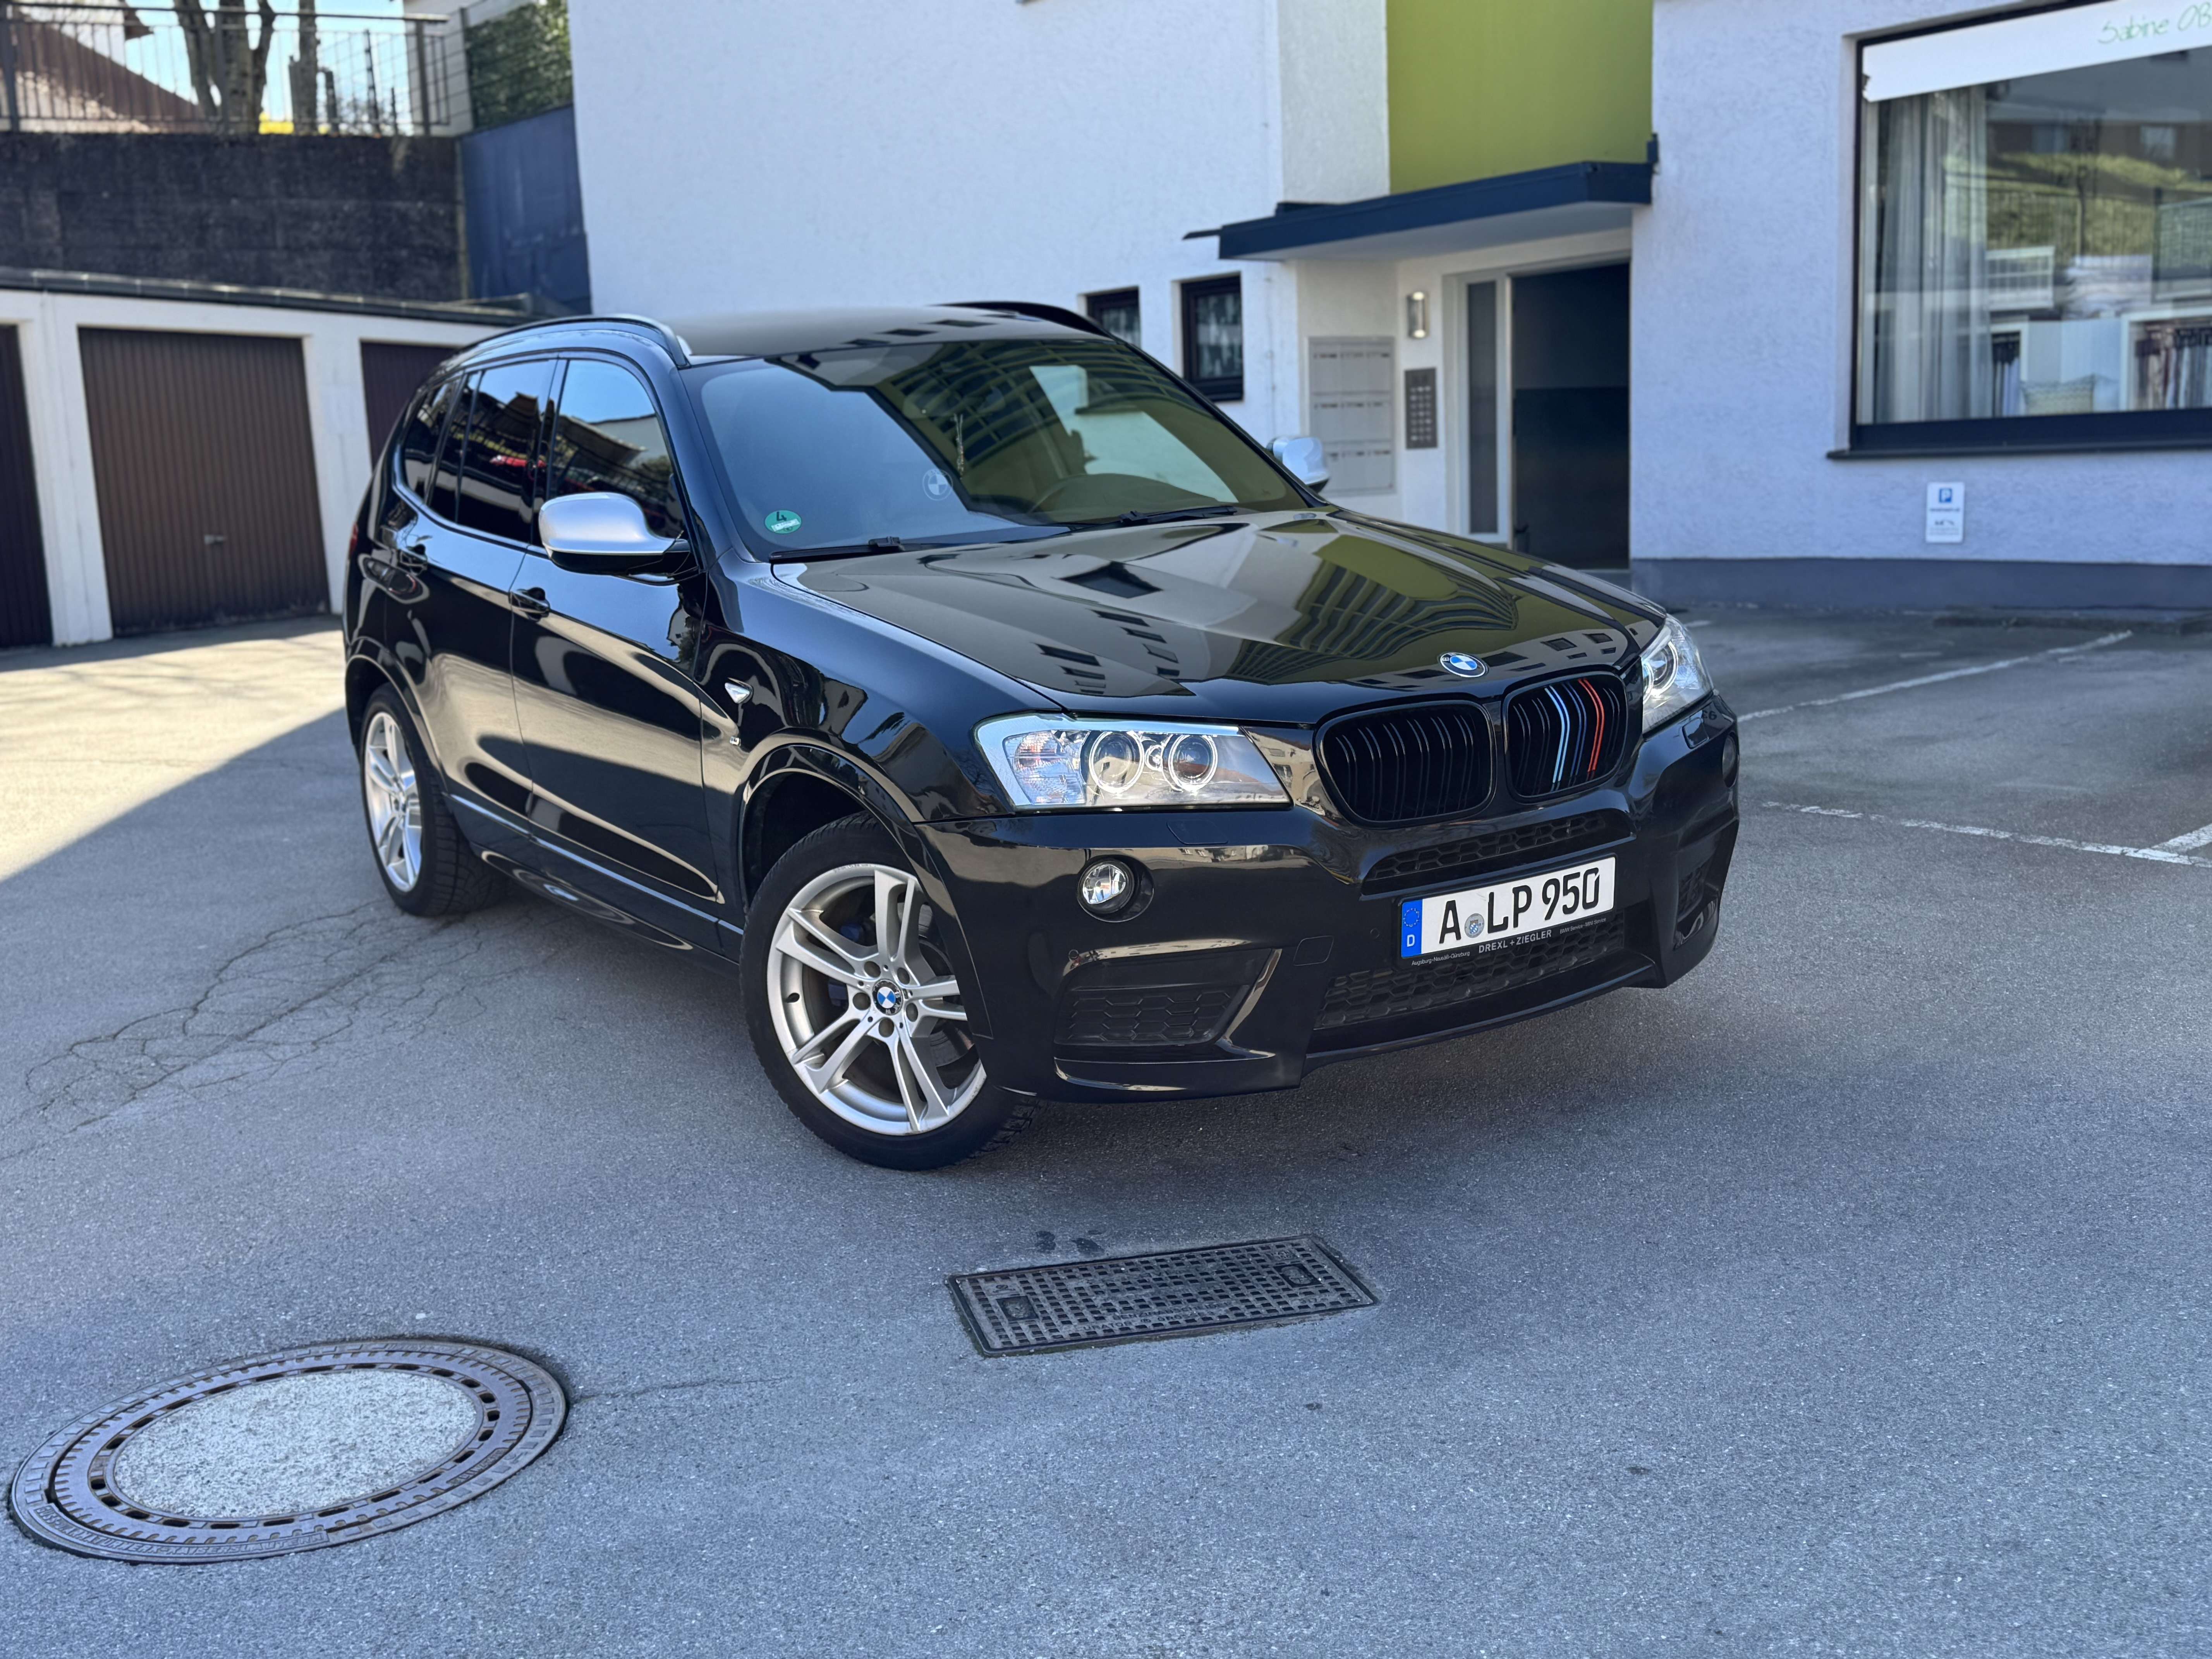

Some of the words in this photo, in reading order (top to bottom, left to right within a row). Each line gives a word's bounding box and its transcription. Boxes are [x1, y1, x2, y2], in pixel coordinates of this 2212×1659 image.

[2097, 15, 2169, 44] Sabine
[776, 511, 787, 521] 4
[1439, 900, 1461, 944] A
[1487, 884, 1532, 934] LP
[1541, 867, 1600, 921] 950
[1407, 933, 1415, 947] D
[1478, 940, 1508, 954] DREXL
[1516, 929, 1552, 945] ZIEGLER
